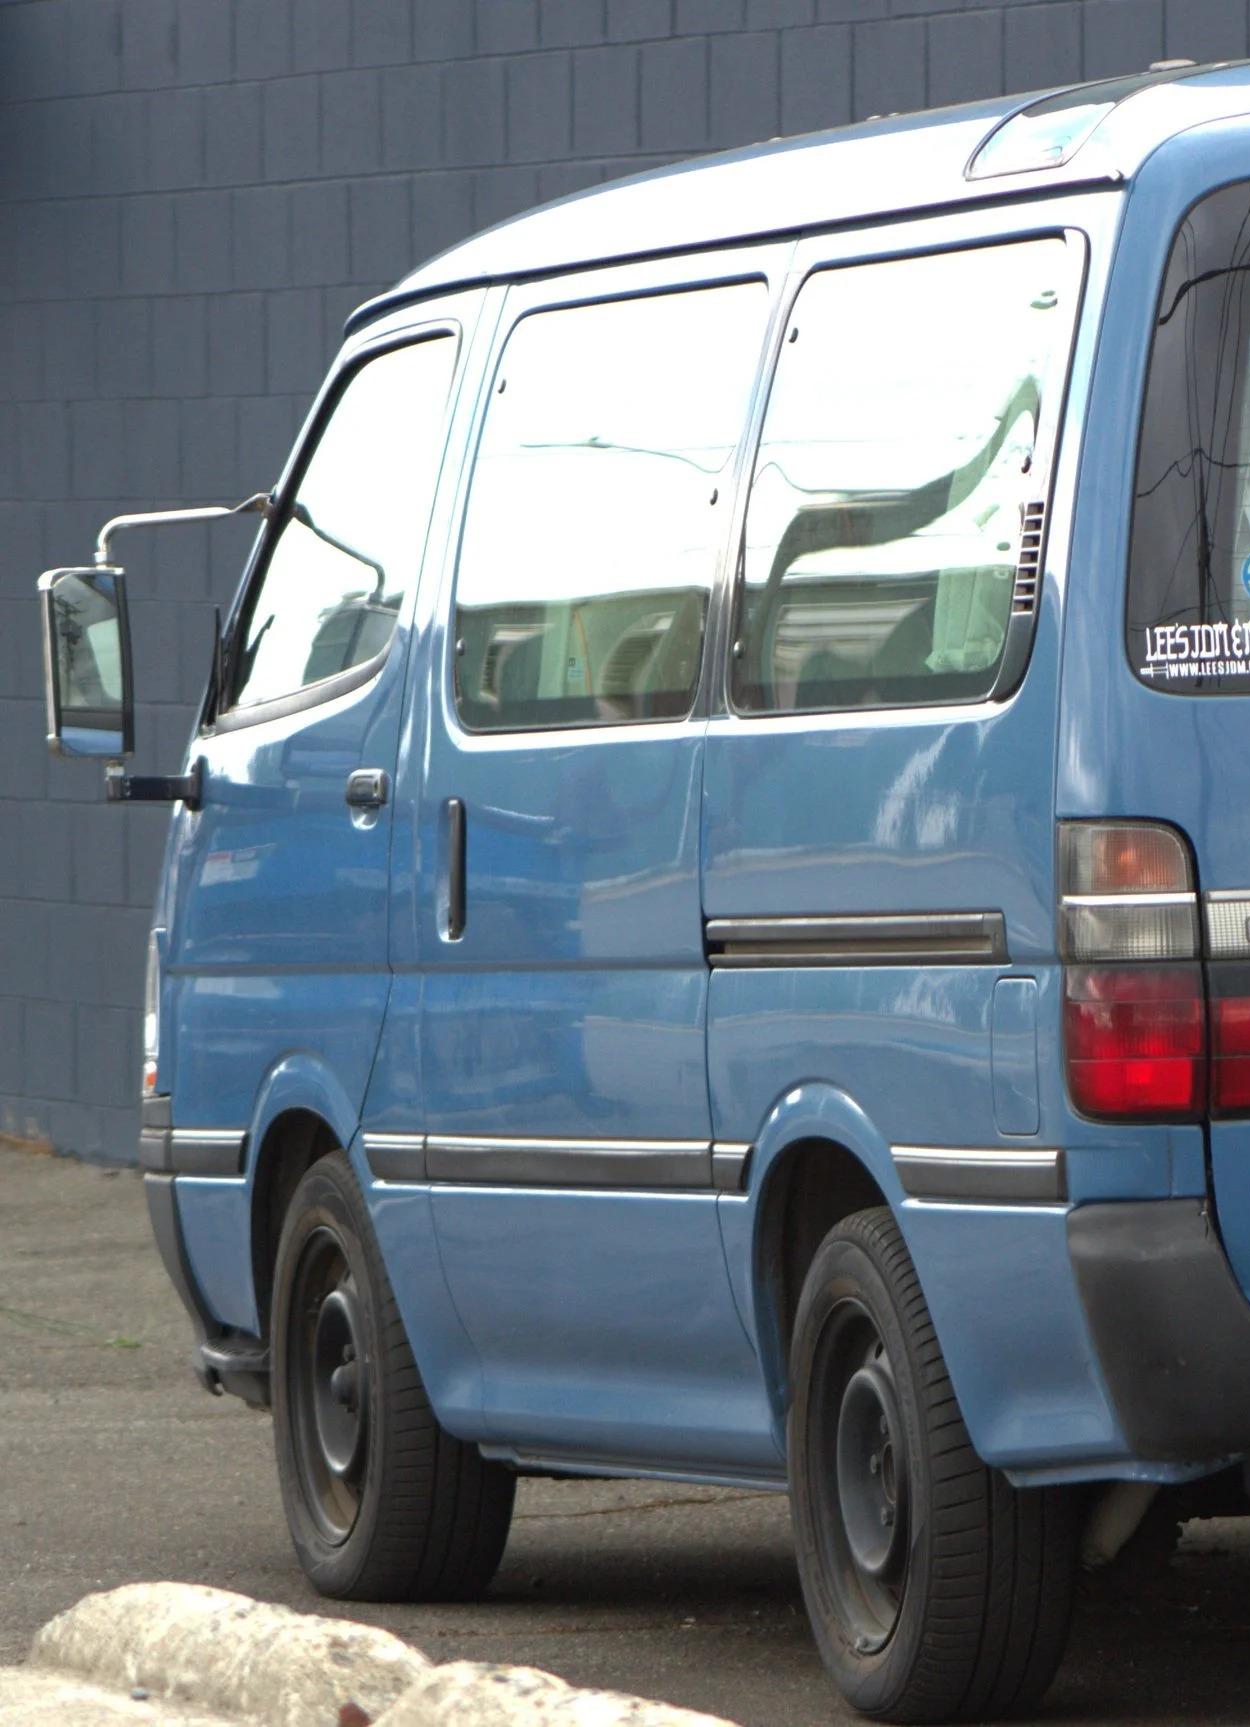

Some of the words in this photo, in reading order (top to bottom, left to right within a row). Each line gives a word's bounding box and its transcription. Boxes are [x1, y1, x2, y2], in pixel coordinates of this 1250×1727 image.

[1145, 623, 1189, 661] LEE'S
[1190, 621, 1230, 659] JDM
[1231, 617, 1242, 657] &
